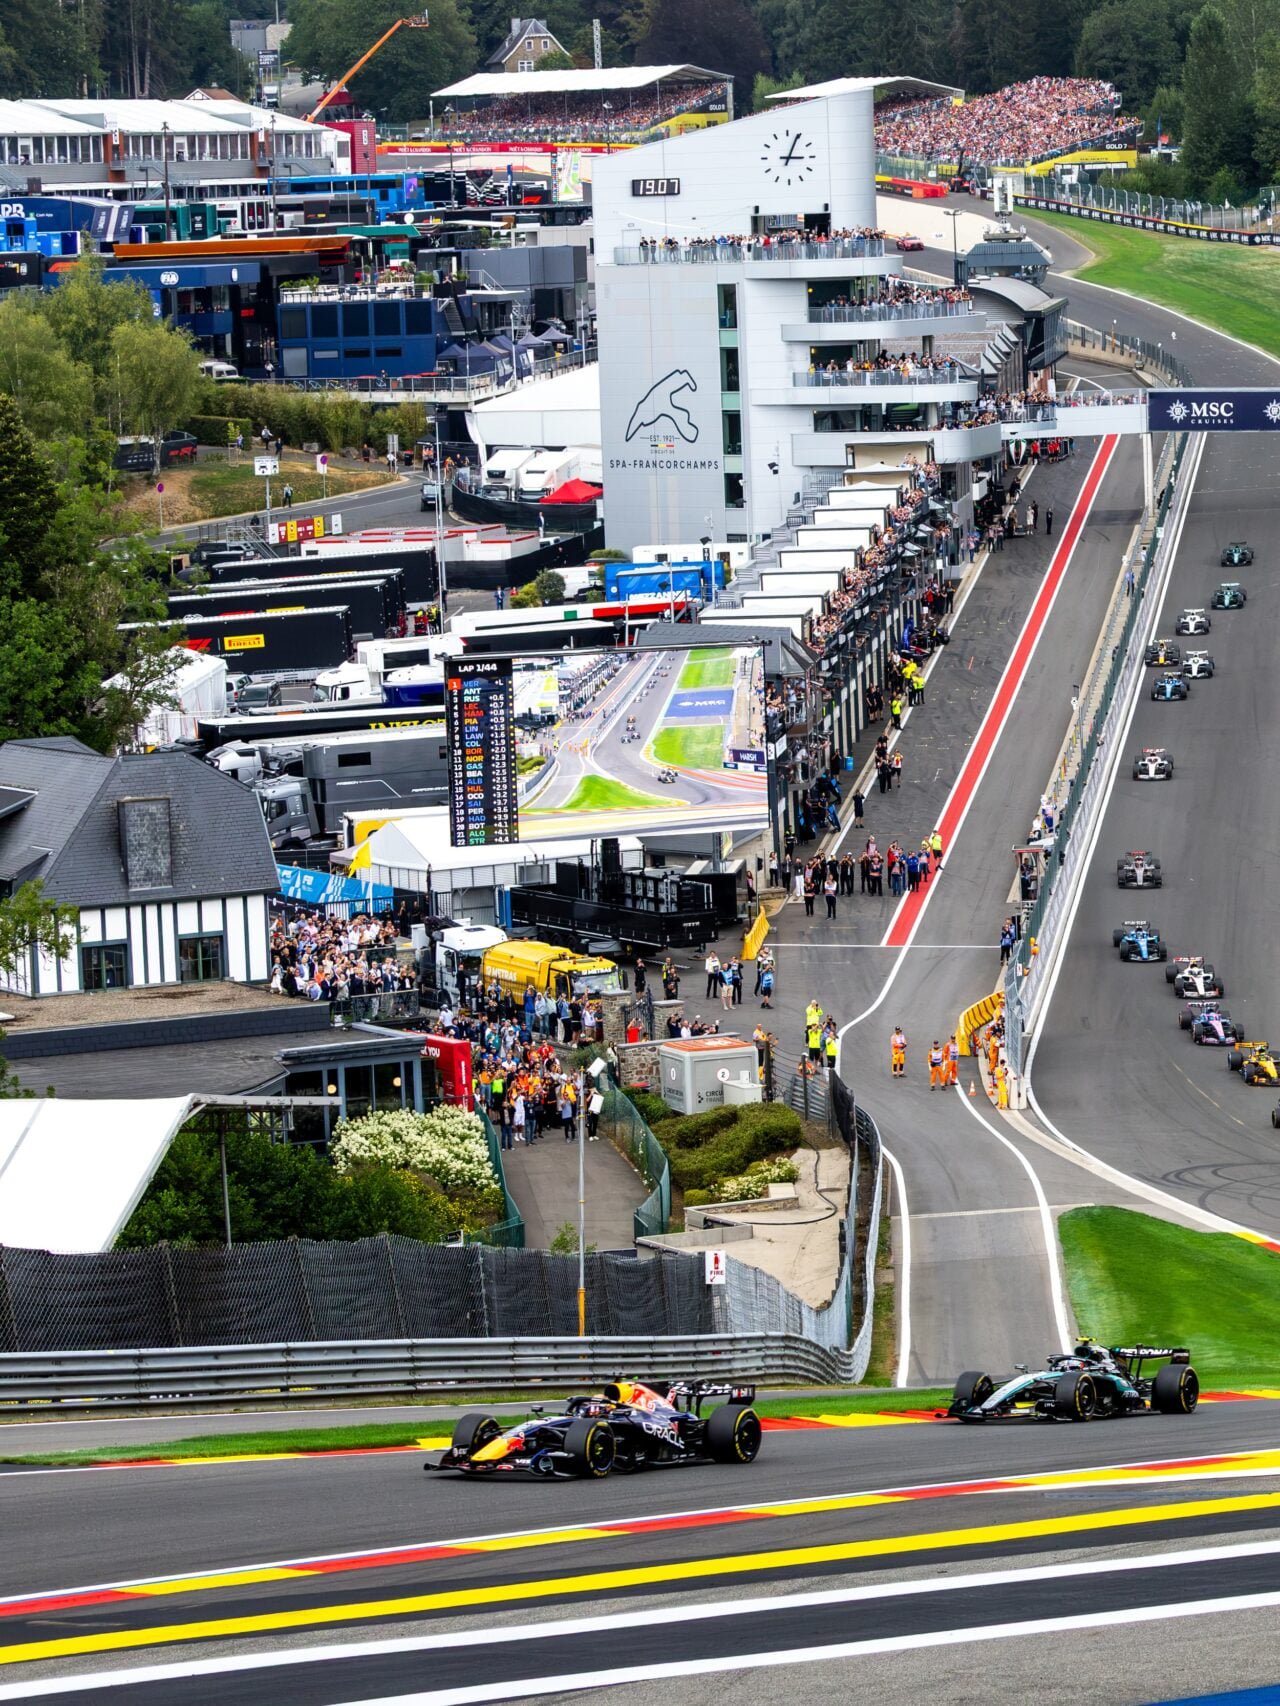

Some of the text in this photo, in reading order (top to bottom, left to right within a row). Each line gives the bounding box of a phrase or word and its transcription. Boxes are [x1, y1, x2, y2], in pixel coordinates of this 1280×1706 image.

[640, 179, 678, 195] 19.07
[1191, 402, 1234, 417] MSC
[610, 460, 719, 470] SPA-FRANCORCHAMPS
[228, 637, 261, 647] PIRELLI
[492, 966, 517, 982] METRAS
[428, 1047, 440, 1057] YOU
